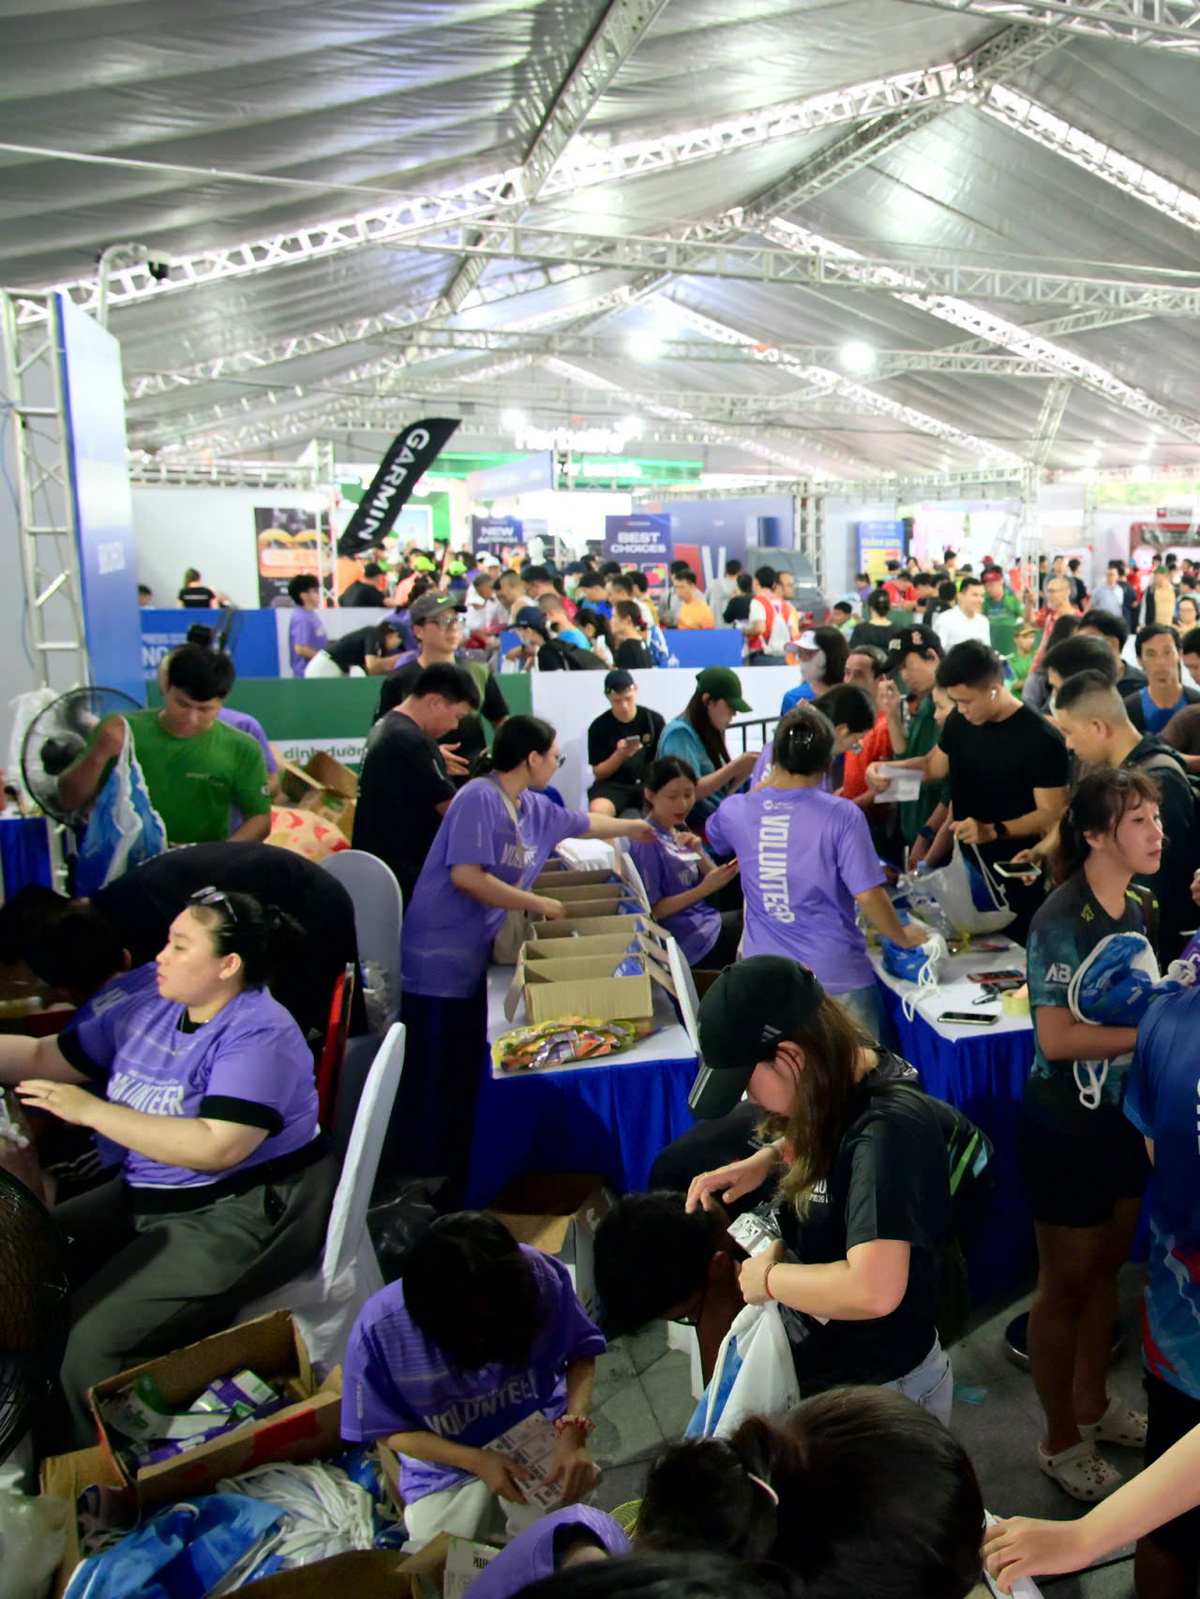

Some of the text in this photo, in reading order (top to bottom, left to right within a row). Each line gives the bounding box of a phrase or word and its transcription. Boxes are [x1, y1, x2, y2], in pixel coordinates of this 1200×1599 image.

[358, 427, 431, 541] GARMIN
[481, 526, 515, 537] NEW
[617, 531, 661, 543] BEST
[610, 543, 667, 554] CHOICES
